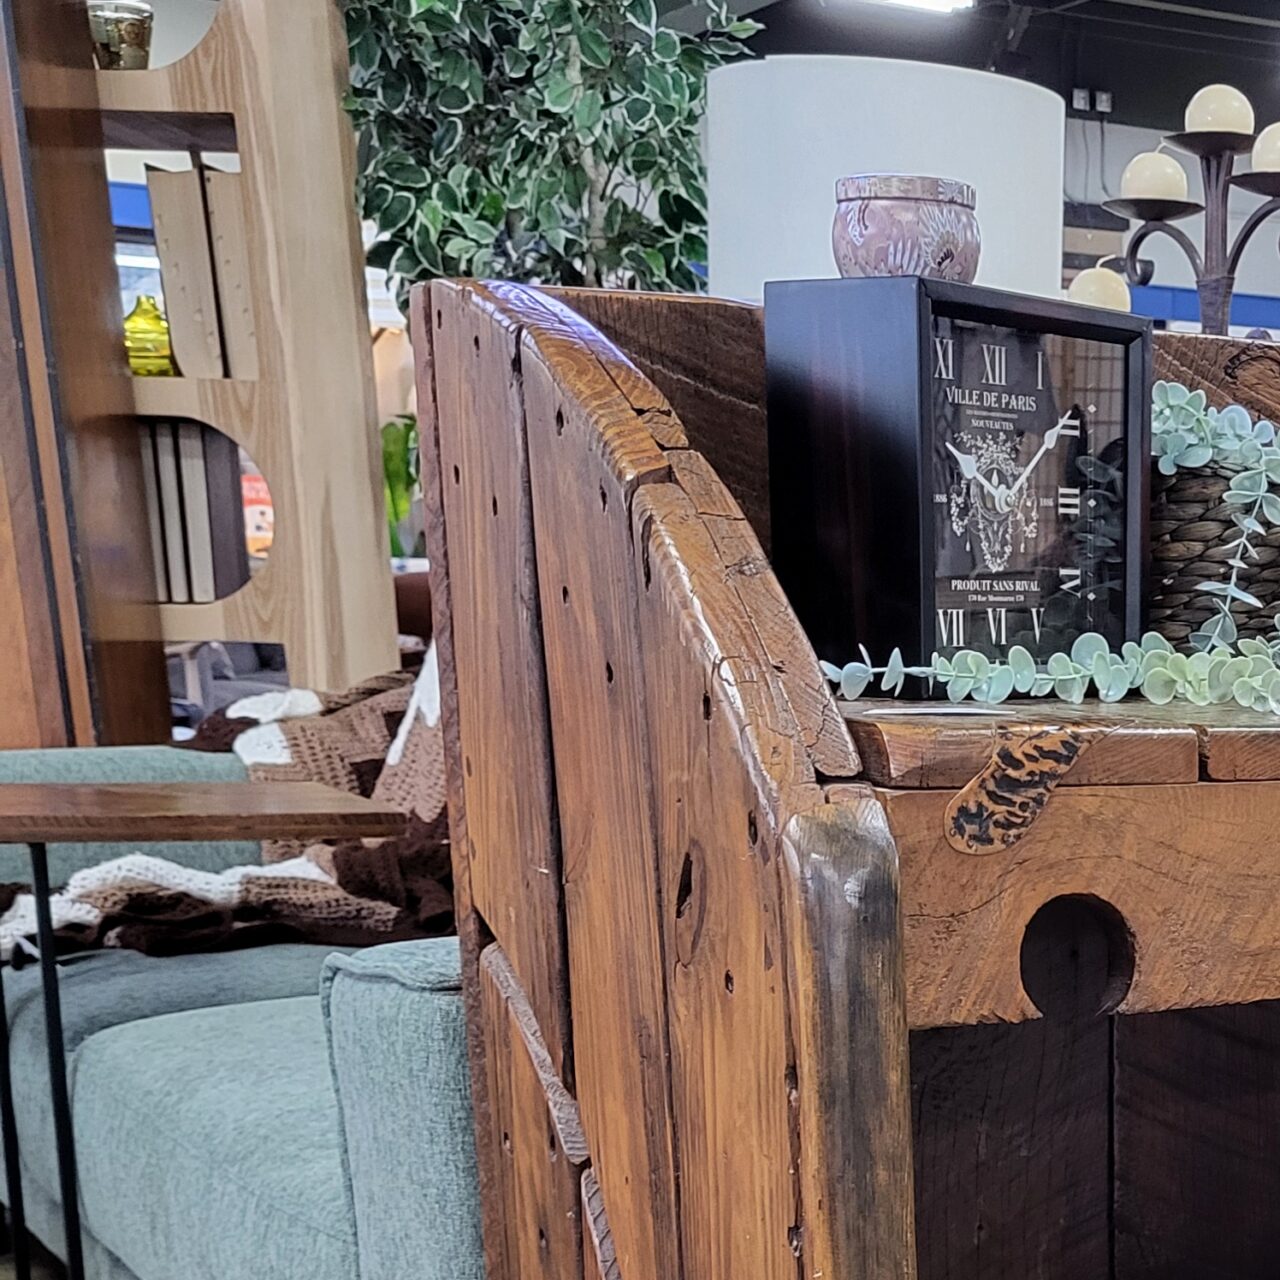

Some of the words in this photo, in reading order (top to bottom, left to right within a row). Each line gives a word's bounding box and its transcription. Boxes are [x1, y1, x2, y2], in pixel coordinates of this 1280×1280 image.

[934, 338, 955, 380] XI
[981, 344, 1007, 386] XII
[1036, 351, 1044, 390] I
[946, 385, 981, 406] VILLE
[983, 391, 999, 408] DE
[1001, 393, 1037, 412] PARIS
[1058, 486, 1081, 516] III
[951, 579, 992, 591] PRODUIT
[992, 580, 1014, 592] SANS
[1015, 580, 1041, 592] RIVAL
[937, 609, 965, 647] VII
[986, 607, 1007, 645] VI
[1030, 607, 1045, 645] V
